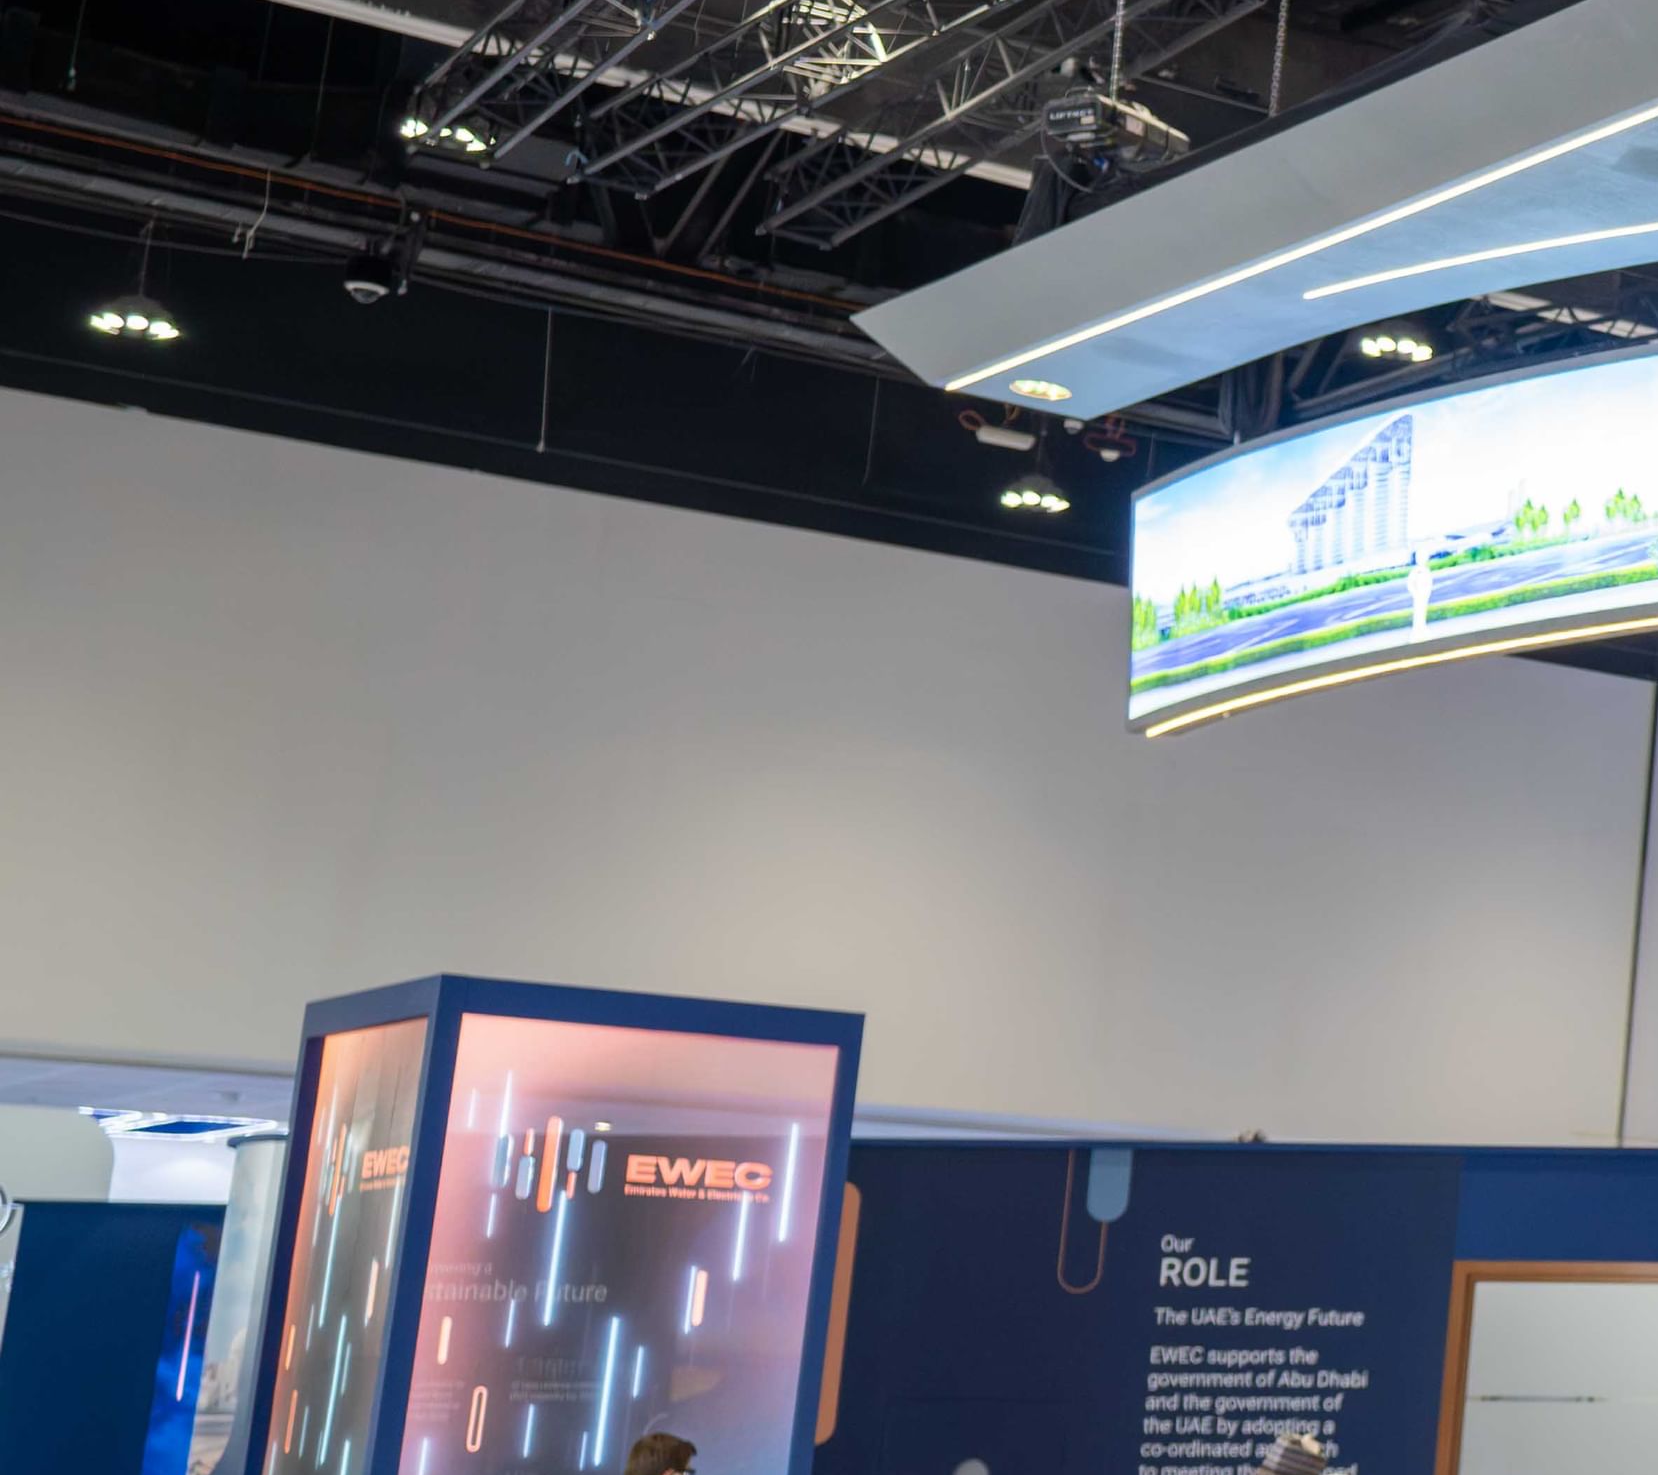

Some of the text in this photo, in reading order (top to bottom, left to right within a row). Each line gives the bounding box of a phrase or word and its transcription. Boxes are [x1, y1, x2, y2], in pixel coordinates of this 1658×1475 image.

[361, 1144, 409, 1179] EWEC
[626, 1154, 774, 1190] EWEC
[1161, 1234, 1195, 1252] Our
[1159, 1257, 1250, 1287] ROLE
[1154, 1307, 1365, 1329] The UAE's Energy Future
[1150, 1346, 1319, 1367] EWEC supports the
[1147, 1370, 1368, 1391] government of Abu Dhabi
[1145, 1394, 1344, 1414] and the government of
[1143, 1416, 1335, 1438] the UAE by adopting a
[1140, 1440, 1252, 1458] co-ordinated
